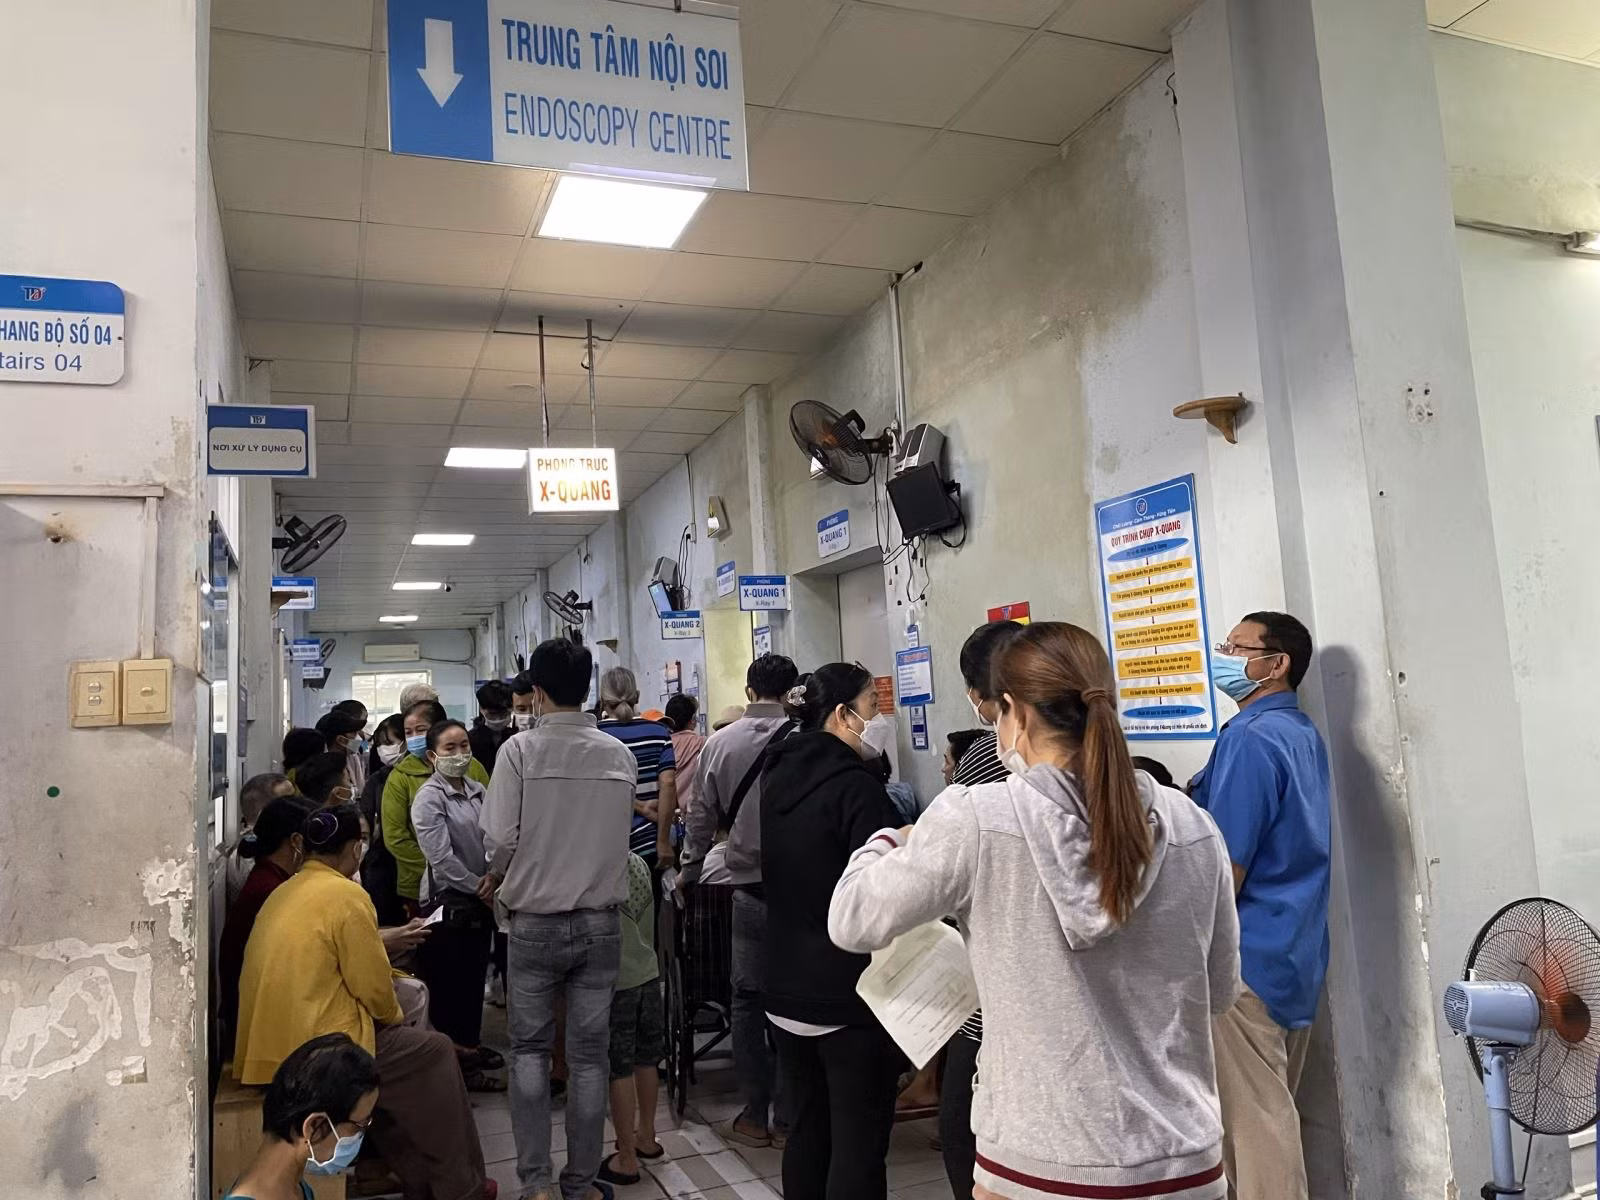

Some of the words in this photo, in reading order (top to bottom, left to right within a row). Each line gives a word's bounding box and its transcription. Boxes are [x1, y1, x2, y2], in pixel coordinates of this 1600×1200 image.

[501, 18, 581, 70] TRUNG
[590, 24, 640, 78] TÂM
[649, 32, 685, 91] NỘI
[694, 47, 729, 90] SOI
[504, 92, 639, 148] ENDOSCOPY
[649, 111, 732, 160] CENTRE
[45, 317, 64, 348] BỘ
[70, 316, 90, 345] SỐ
[94, 325, 112, 346] 04
[54, 353, 82, 372] 04
[540, 479, 611, 503] X-QUANG
[820, 528, 843, 544] X-QUANG
[1111, 536, 1121, 547] QUY
[1155, 519, 1181, 536] X-QUANG
[743, 587, 780, 598] X-QUANG
[781, 588, 786, 597] 1
[664, 620, 695, 629] X-QUANG
[695, 620, 700, 628] 2
